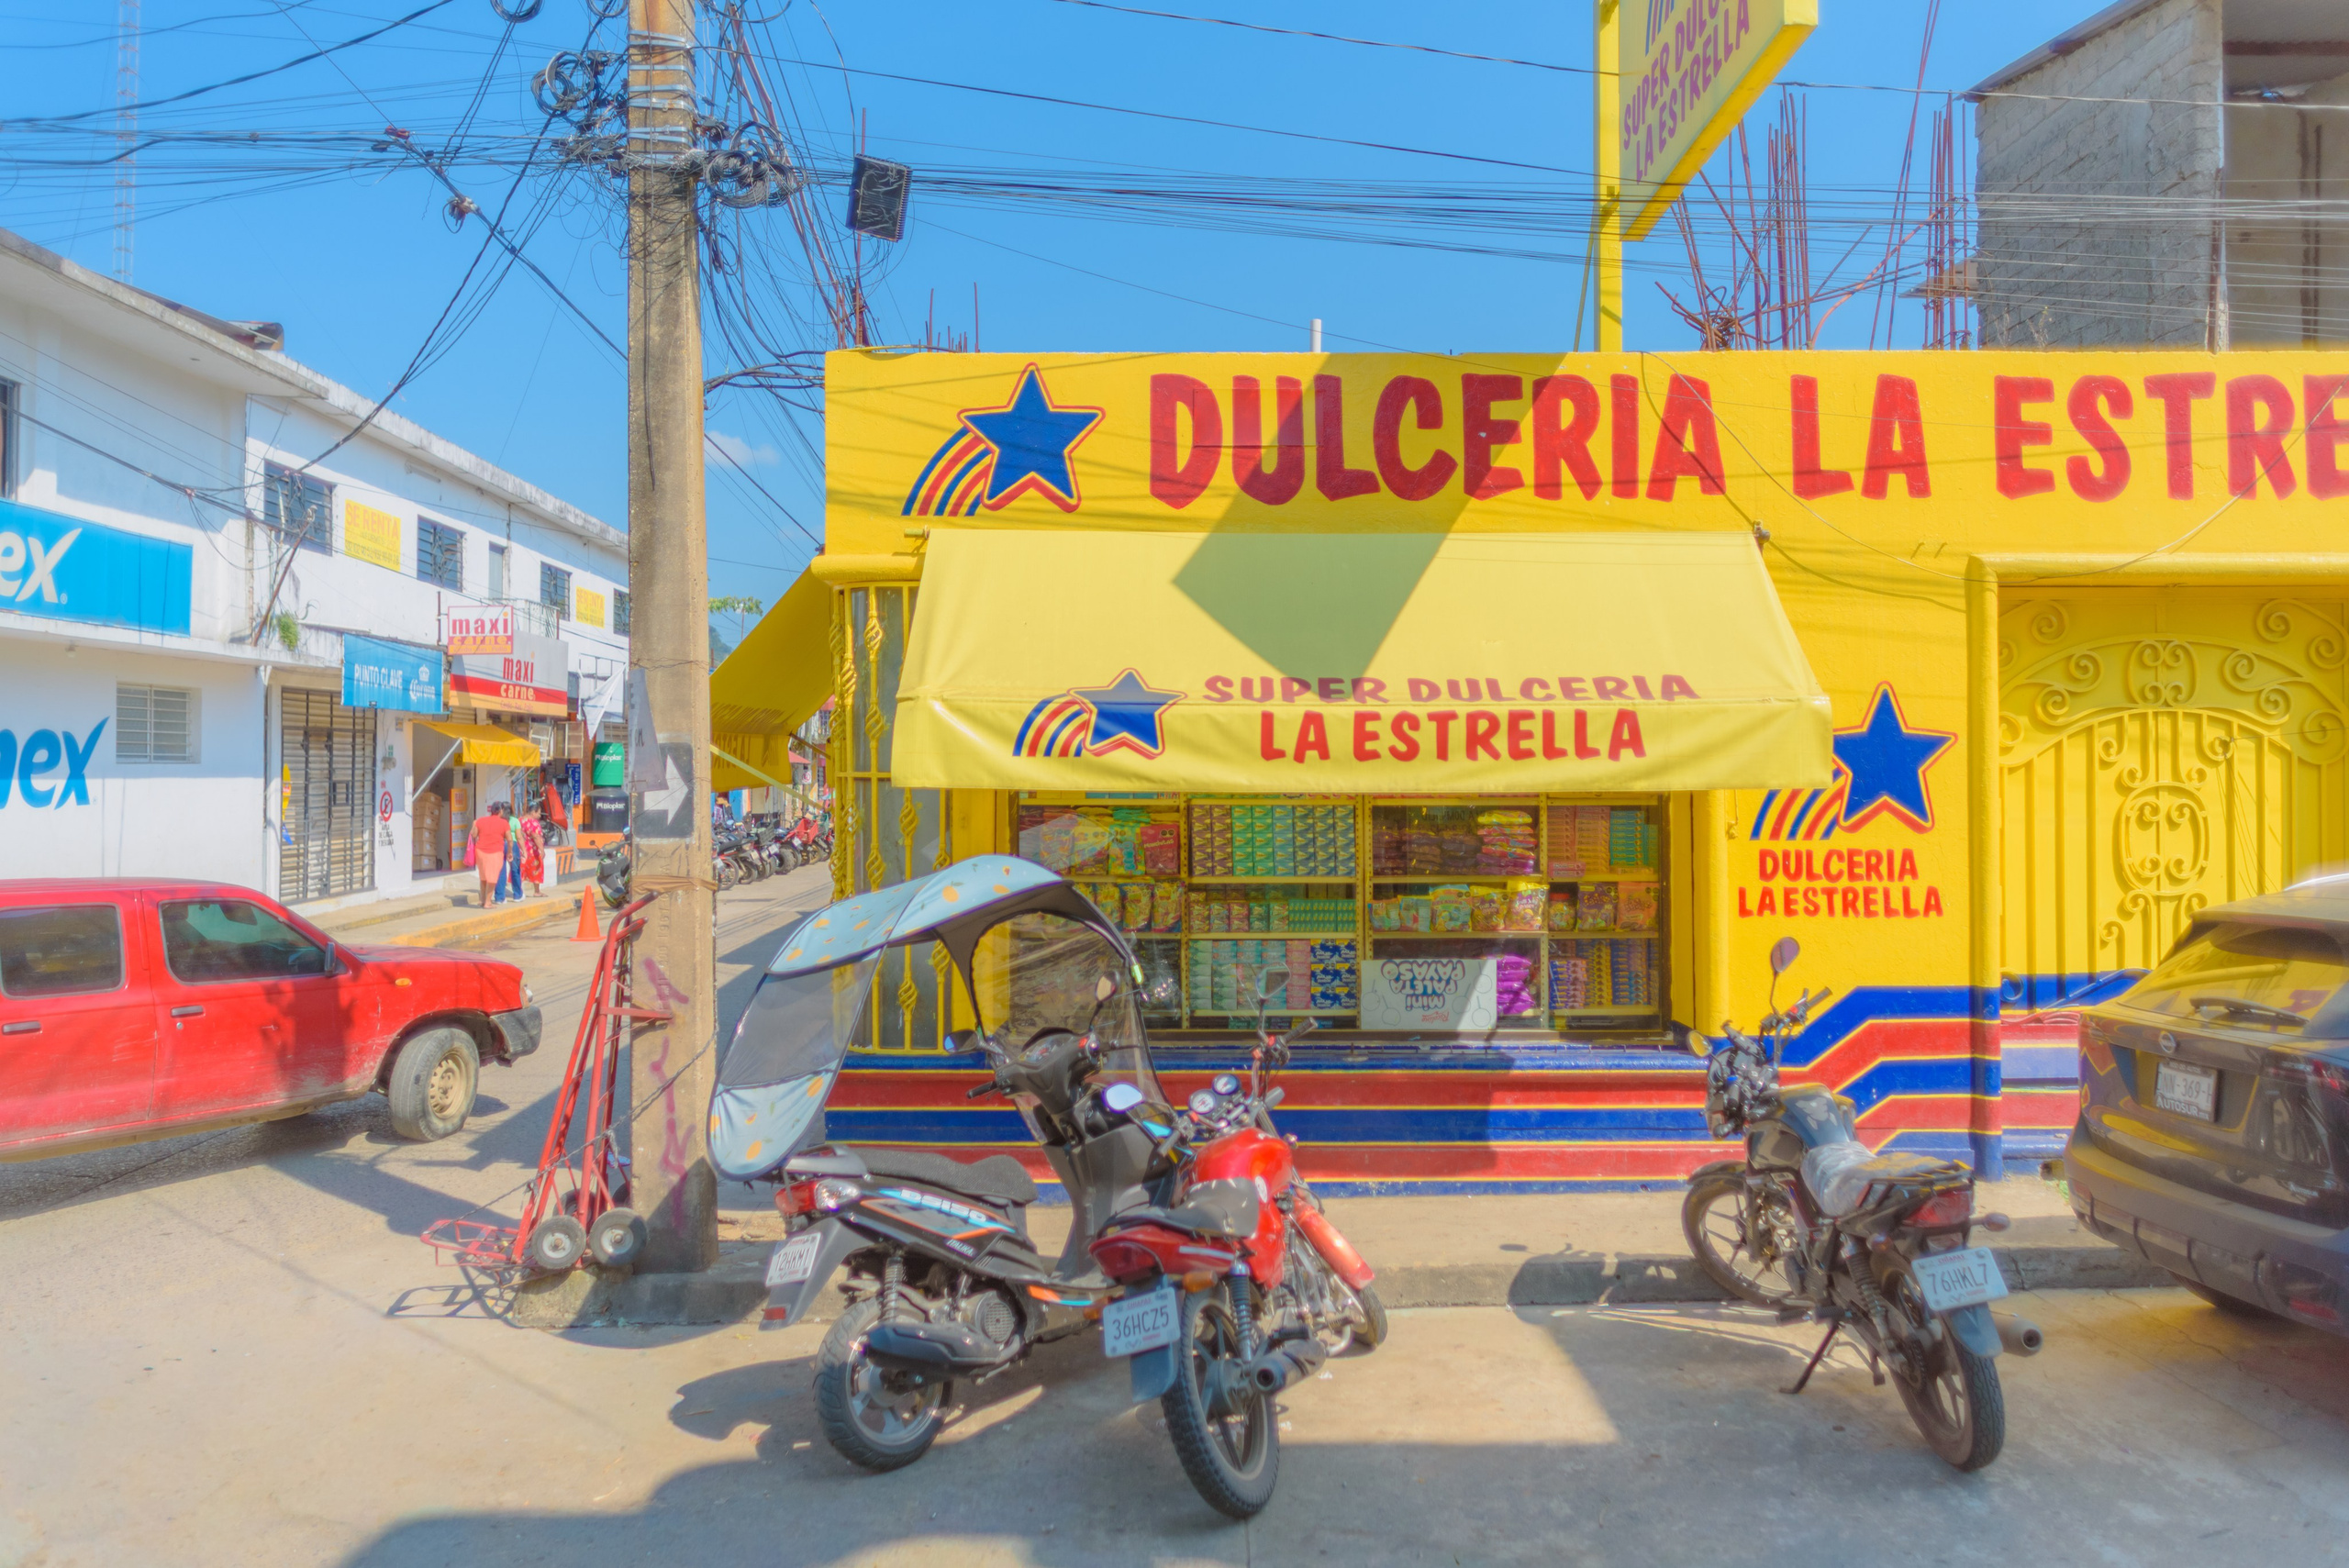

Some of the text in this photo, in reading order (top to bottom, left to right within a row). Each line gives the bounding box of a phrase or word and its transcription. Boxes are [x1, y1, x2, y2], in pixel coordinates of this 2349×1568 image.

[1623, 41, 1670, 150] SUPER
[1636, 0, 1750, 185] LA ESTRELLA
[1149, 371, 2349, 510] DULCERIA LA ESTRE
[345, 502, 361, 528] SE
[362, 508, 400, 543] RENTA
[451, 611, 509, 635] maxi
[452, 635, 508, 646] carne
[354, 663, 403, 690] PUNTO CLAVE
[503, 651, 535, 684] maxi
[409, 679, 436, 702] Corona
[500, 684, 534, 701] carne
[1202, 674, 1701, 704] SUPER DULCERIA
[1260, 708, 1647, 764] LA ESTRELLA
[1758, 848, 1920, 884] DULCERIA
[1738, 885, 1943, 918] LA ESTRELLA
[1380, 960, 1466, 982] PAYASO
[1389, 979, 1458, 995] PALETA
[946, 1239, 974, 1257] ITALIKA
[1927, 1262, 1987, 1295] 76HKL7
[1112, 1305, 1169, 1340] 36HCZ5
